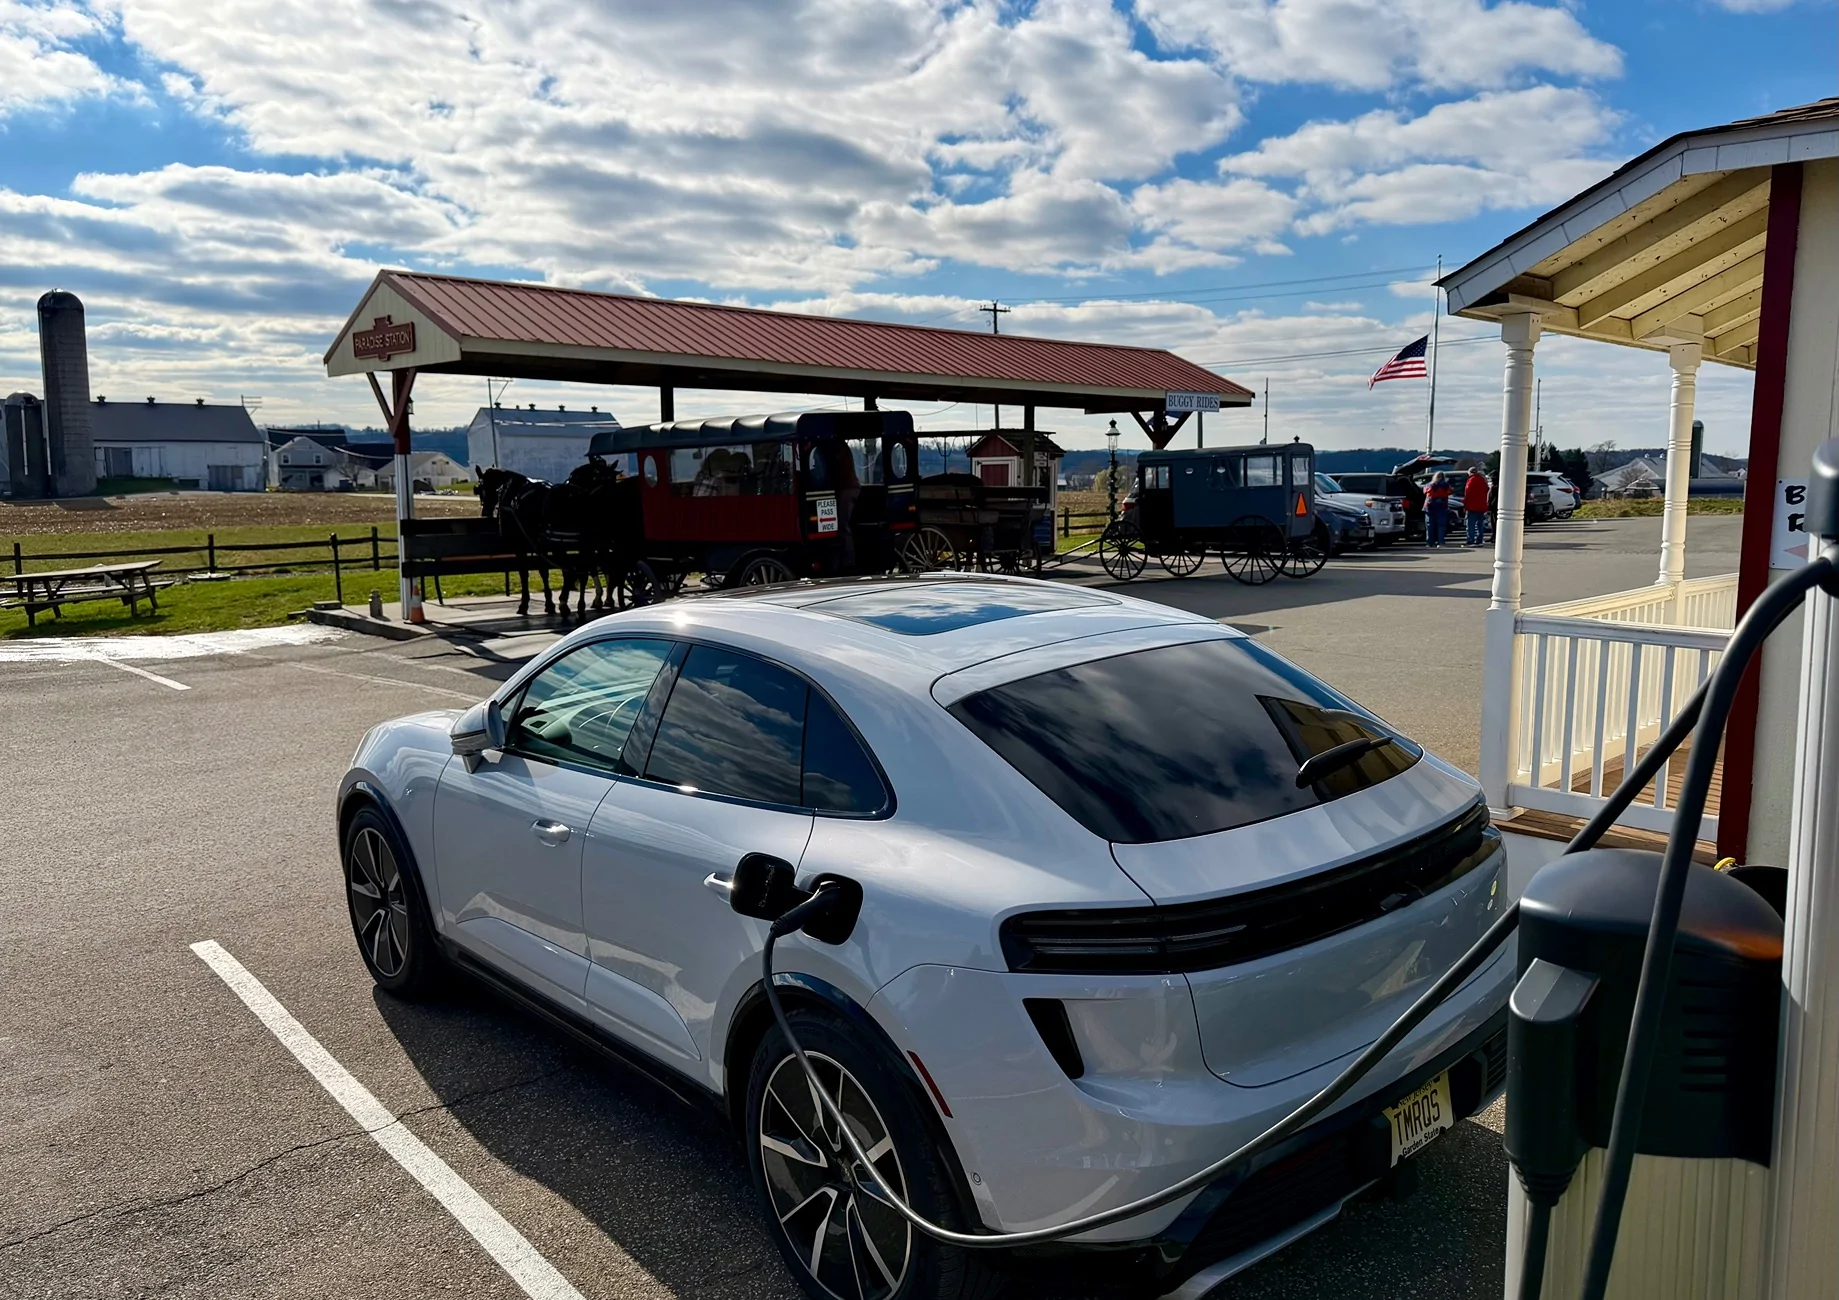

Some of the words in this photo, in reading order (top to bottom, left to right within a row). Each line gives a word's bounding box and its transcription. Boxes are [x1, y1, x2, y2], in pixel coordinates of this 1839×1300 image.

[355, 334, 384, 351] PARADISE
[385, 330, 410, 347] STATION
[1168, 394, 1194, 408] BUGGY
[1196, 396, 1219, 409] RIDES
[817, 500, 836, 508] PLEASE
[821, 508, 834, 516] PASS
[821, 523, 835, 531] WIDE
[1413, 1080, 1433, 1101] Jersey
[1402, 1139, 1424, 1157] Garden
[1423, 1127, 1440, 1143] State
